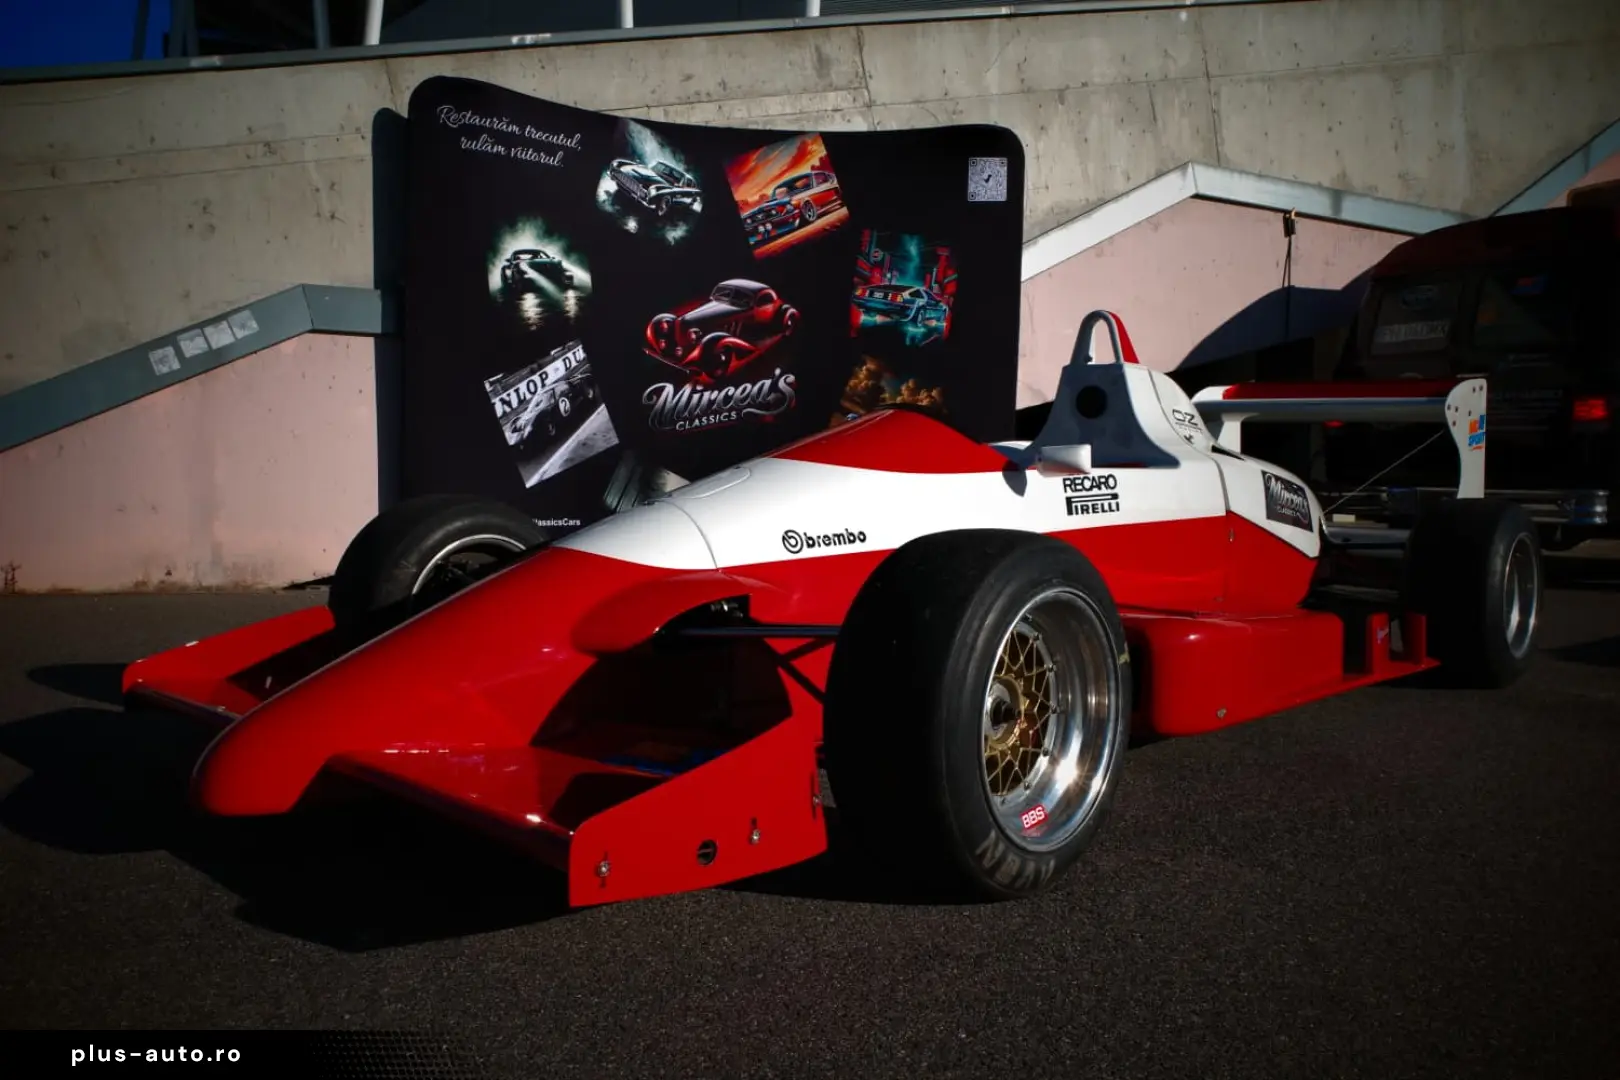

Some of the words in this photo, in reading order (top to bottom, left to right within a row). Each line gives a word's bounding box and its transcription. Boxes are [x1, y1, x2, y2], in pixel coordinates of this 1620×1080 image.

[436, 105, 522, 135] Restaurăm
[525, 124, 581, 151] trecutul,
[460, 134, 507, 156] rulăm
[510, 146, 564, 167] viitorul.
[642, 367, 796, 431] Mircea's
[676, 412, 737, 431] CLASSICS
[1062, 473, 1118, 493] RECARO
[1065, 492, 1120, 516] PIRELLI
[803, 528, 867, 549] brembo
[1022, 806, 1045, 828] BBS
